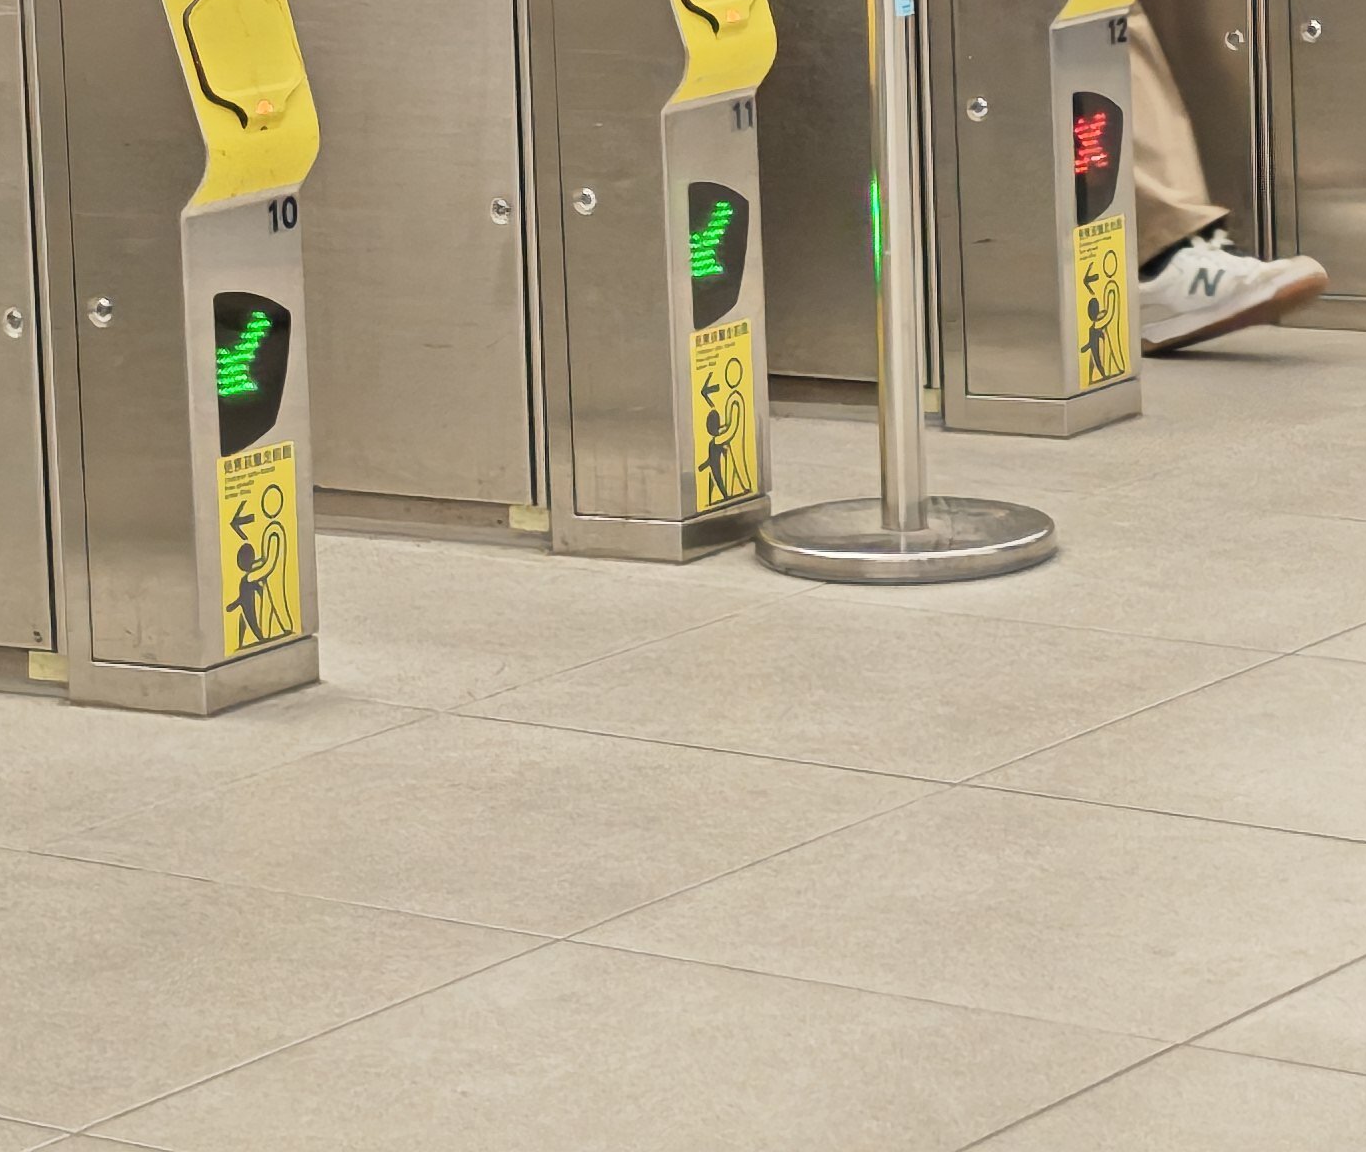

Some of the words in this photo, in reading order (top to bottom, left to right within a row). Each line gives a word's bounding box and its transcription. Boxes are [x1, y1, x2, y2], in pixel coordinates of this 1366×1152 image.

[1109, 18, 1127, 44] 12
[733, 101, 754, 130] 11
[268, 196, 298, 233] 10
[1188, 267, 1225, 297] N
